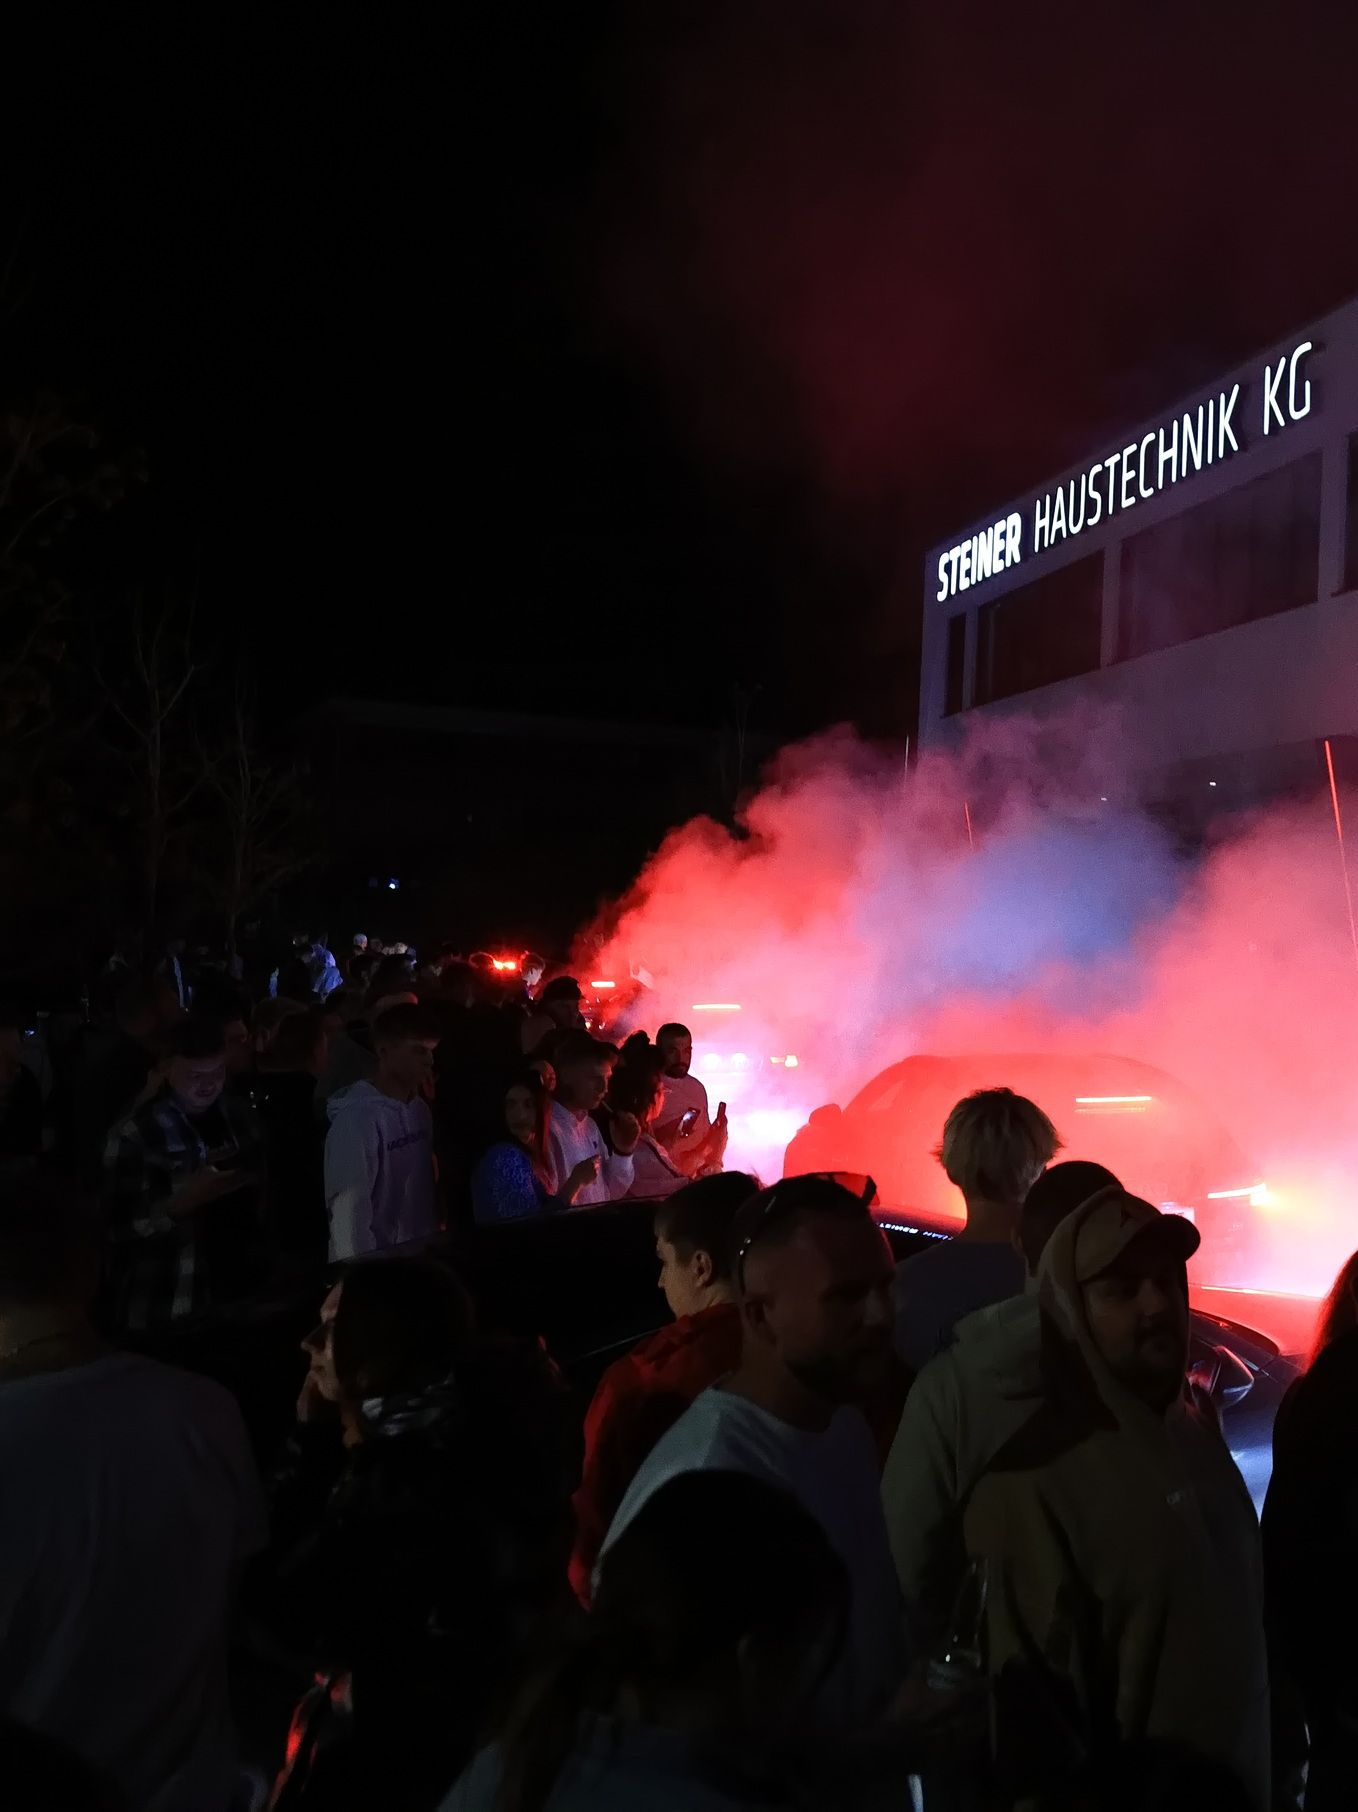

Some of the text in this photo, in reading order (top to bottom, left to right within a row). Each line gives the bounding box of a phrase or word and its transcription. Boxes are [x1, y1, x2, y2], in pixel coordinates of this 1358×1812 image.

[936, 341, 1313, 602] STEINER HAUSTECHNIK KG
